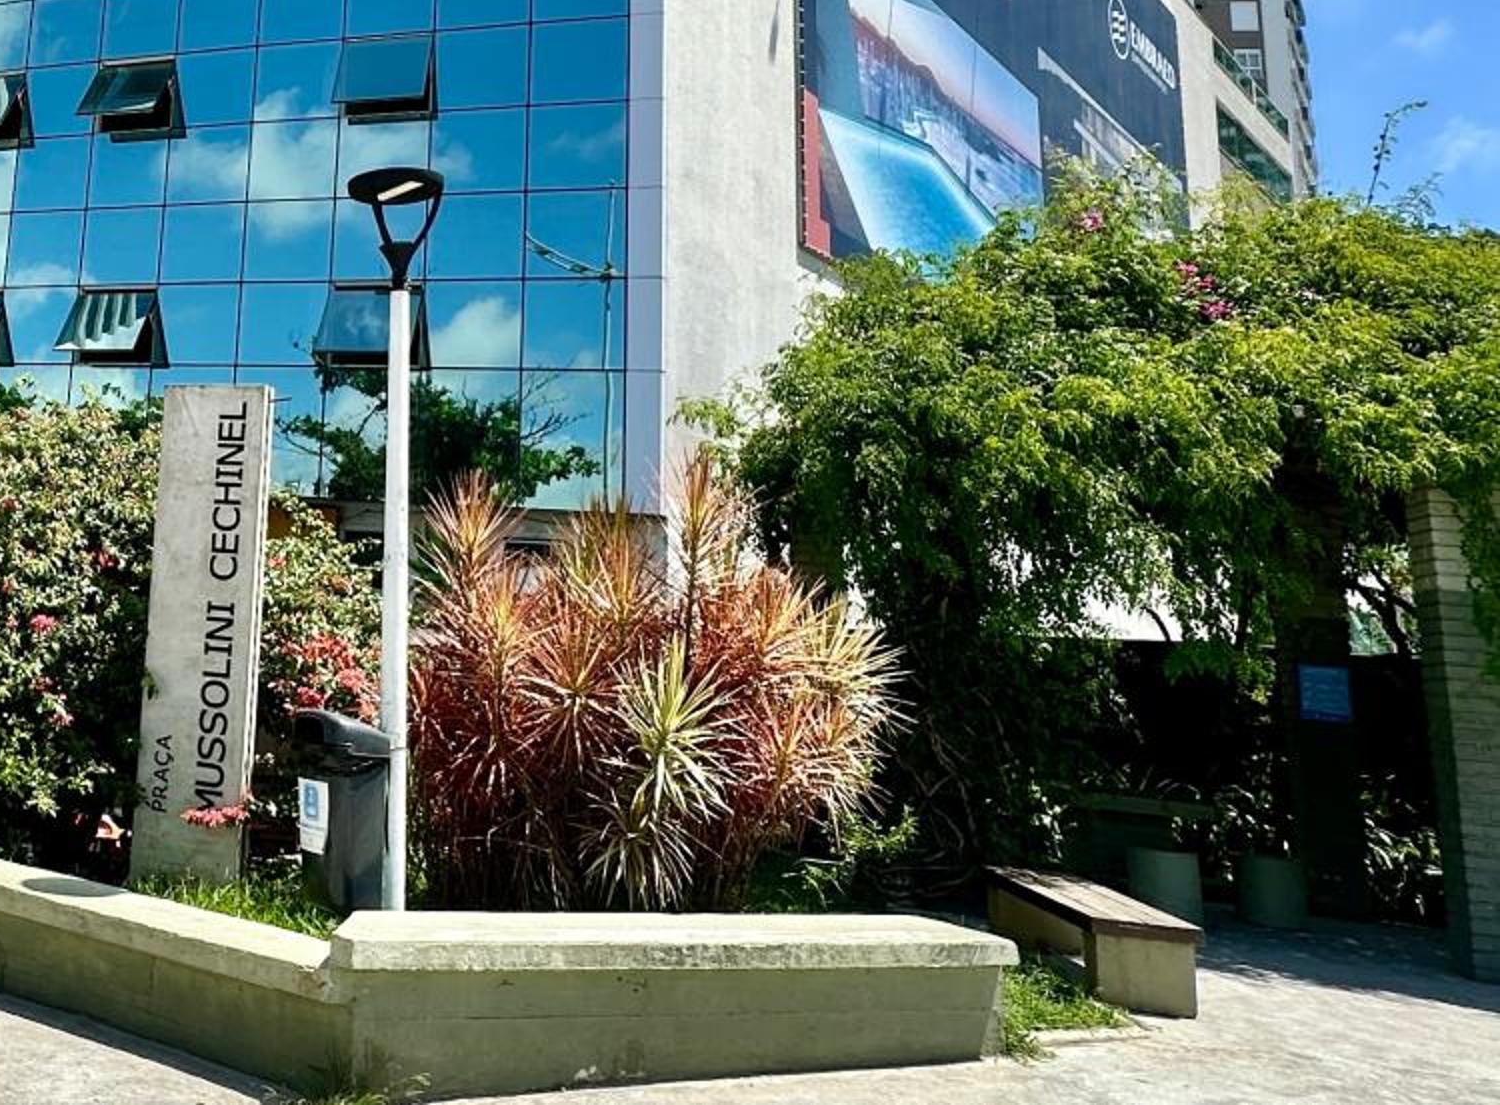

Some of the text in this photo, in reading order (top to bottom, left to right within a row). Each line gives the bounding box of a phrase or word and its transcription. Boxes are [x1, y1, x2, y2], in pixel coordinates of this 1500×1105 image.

[194, 401, 247, 812] MUSSOLINI CECHINEL
[151, 734, 174, 813] PRAÇA
